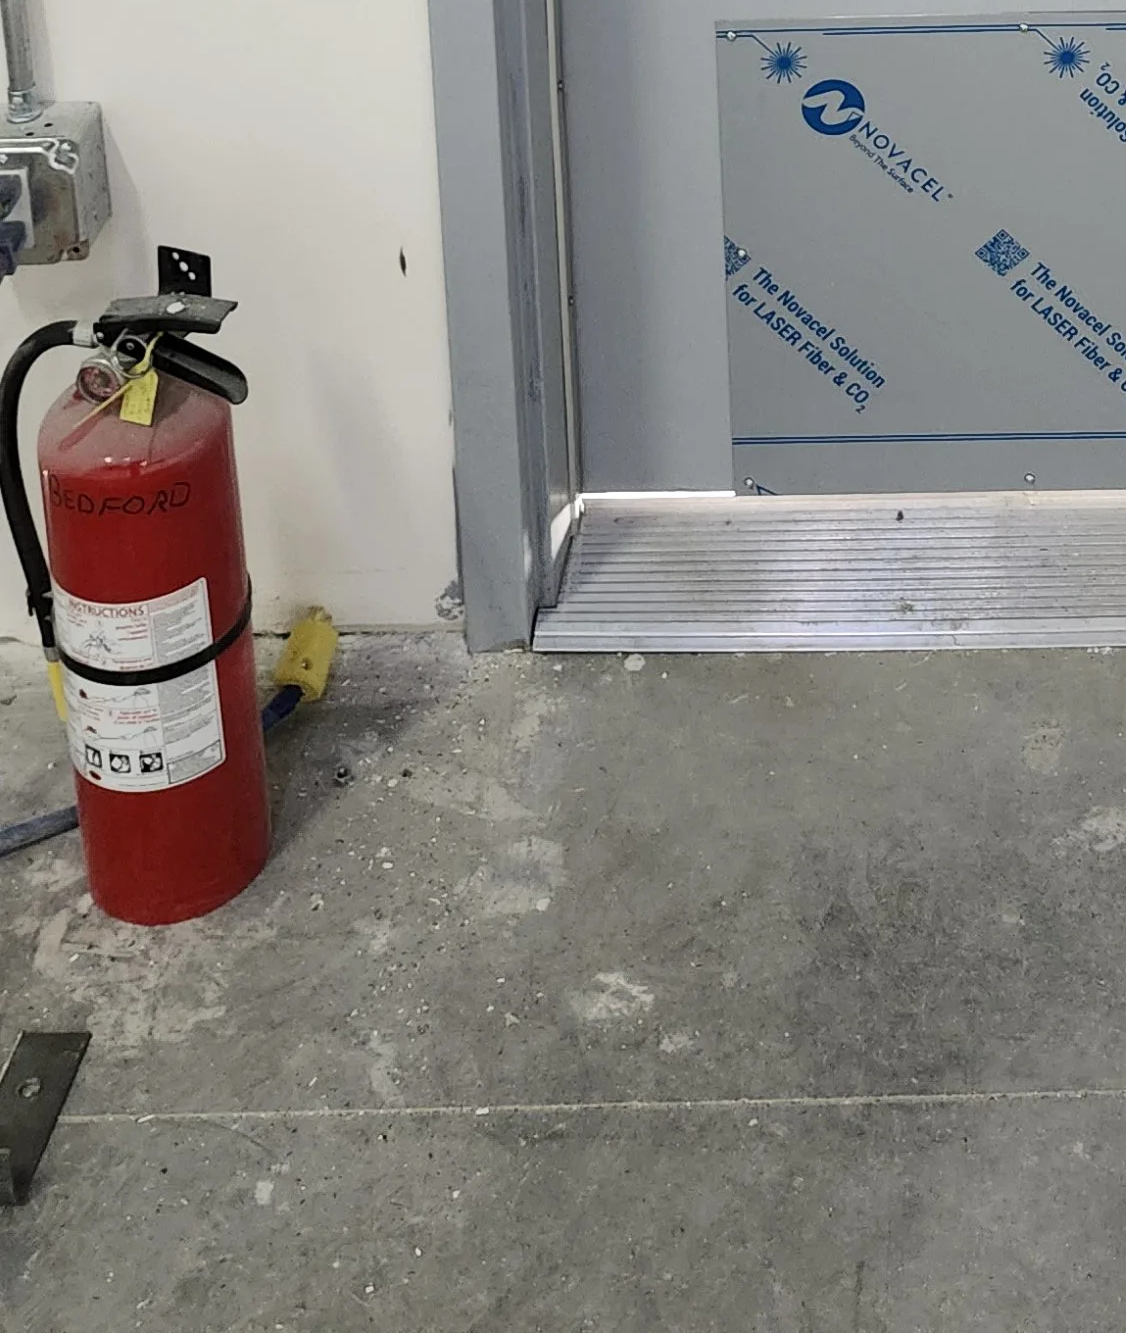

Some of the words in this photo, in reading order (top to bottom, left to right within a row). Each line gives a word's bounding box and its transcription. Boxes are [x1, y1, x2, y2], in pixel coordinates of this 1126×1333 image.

[848, 133, 876, 159] Beyond
[873, 154, 890, 172] The
[887, 167, 915, 194] Surface
[858, 120, 945, 202] NOVACEL
[732, 283, 758, 307] for
[752, 301, 803, 347] LASER
[797, 340, 837, 376] Fiber
[832, 371, 849, 387] &
[752, 266, 780, 296] The
[776, 289, 837, 342] Novacel
[829, 336, 886, 389] Solution
[1009, 278, 1035, 302] for
[1030, 296, 1080, 342] LASER
[1073, 336, 1112, 372] Fiber
[1107, 367, 1124, 383] &
[1030, 261, 1058, 291] The
[1054, 285, 1112, 337] Novacel
[49, 473, 192, 516] BEDFORD
[68, 599, 145, 619] INSTRUCTIONS
